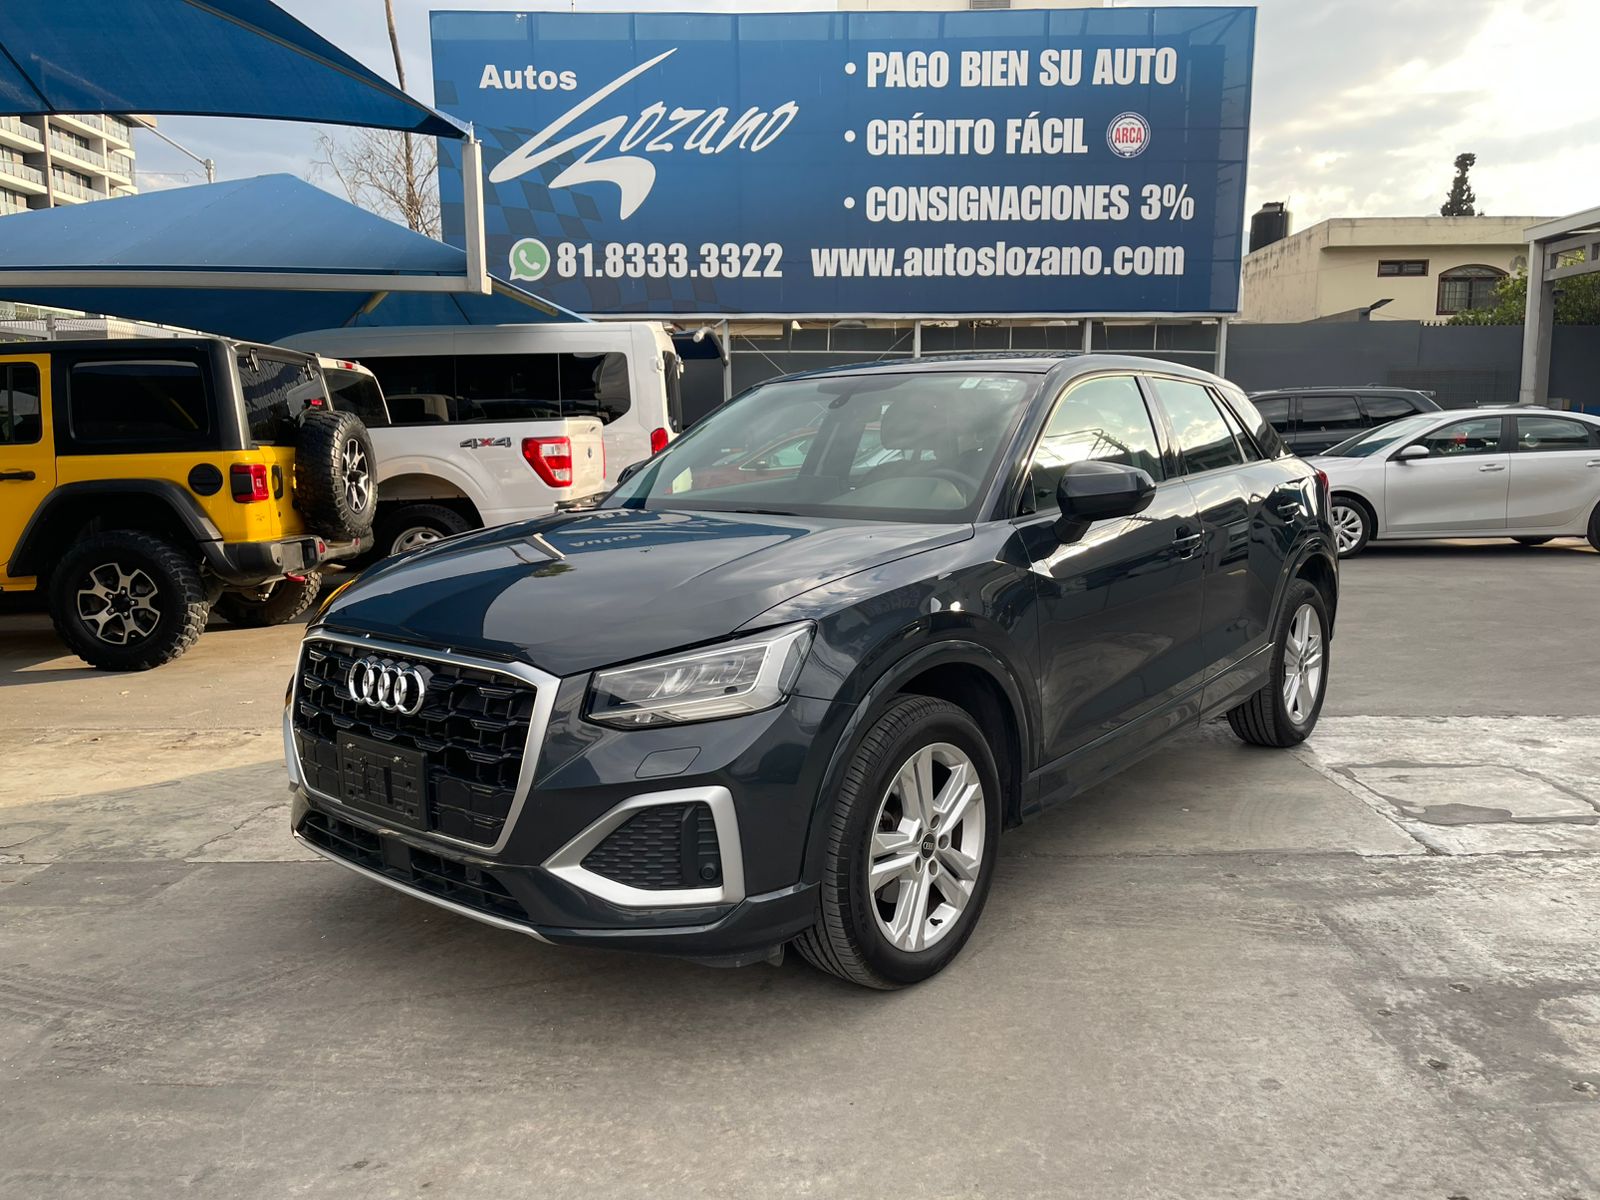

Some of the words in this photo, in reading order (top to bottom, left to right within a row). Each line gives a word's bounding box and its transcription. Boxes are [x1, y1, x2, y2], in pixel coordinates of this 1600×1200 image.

[479, 64, 578, 91] Autos
[867, 51, 950, 88] PAGO
[960, 50, 1029, 86] BIEN
[1038, 49, 1083, 86] SU
[1092, 47, 1178, 84] AUTO
[488, 47, 800, 221] Lozano
[866, 112, 996, 156] CRÉDITO
[1005, 111, 1089, 154] FÁCIL
[1114, 127, 1143, 144] ARCA
[866, 184, 1130, 222] CONSIGNACIONES
[1140, 184, 1195, 220] 3%
[556, 242, 783, 278] 81.8333.3322
[810, 241, 1185, 277] www.autoslozano.com
